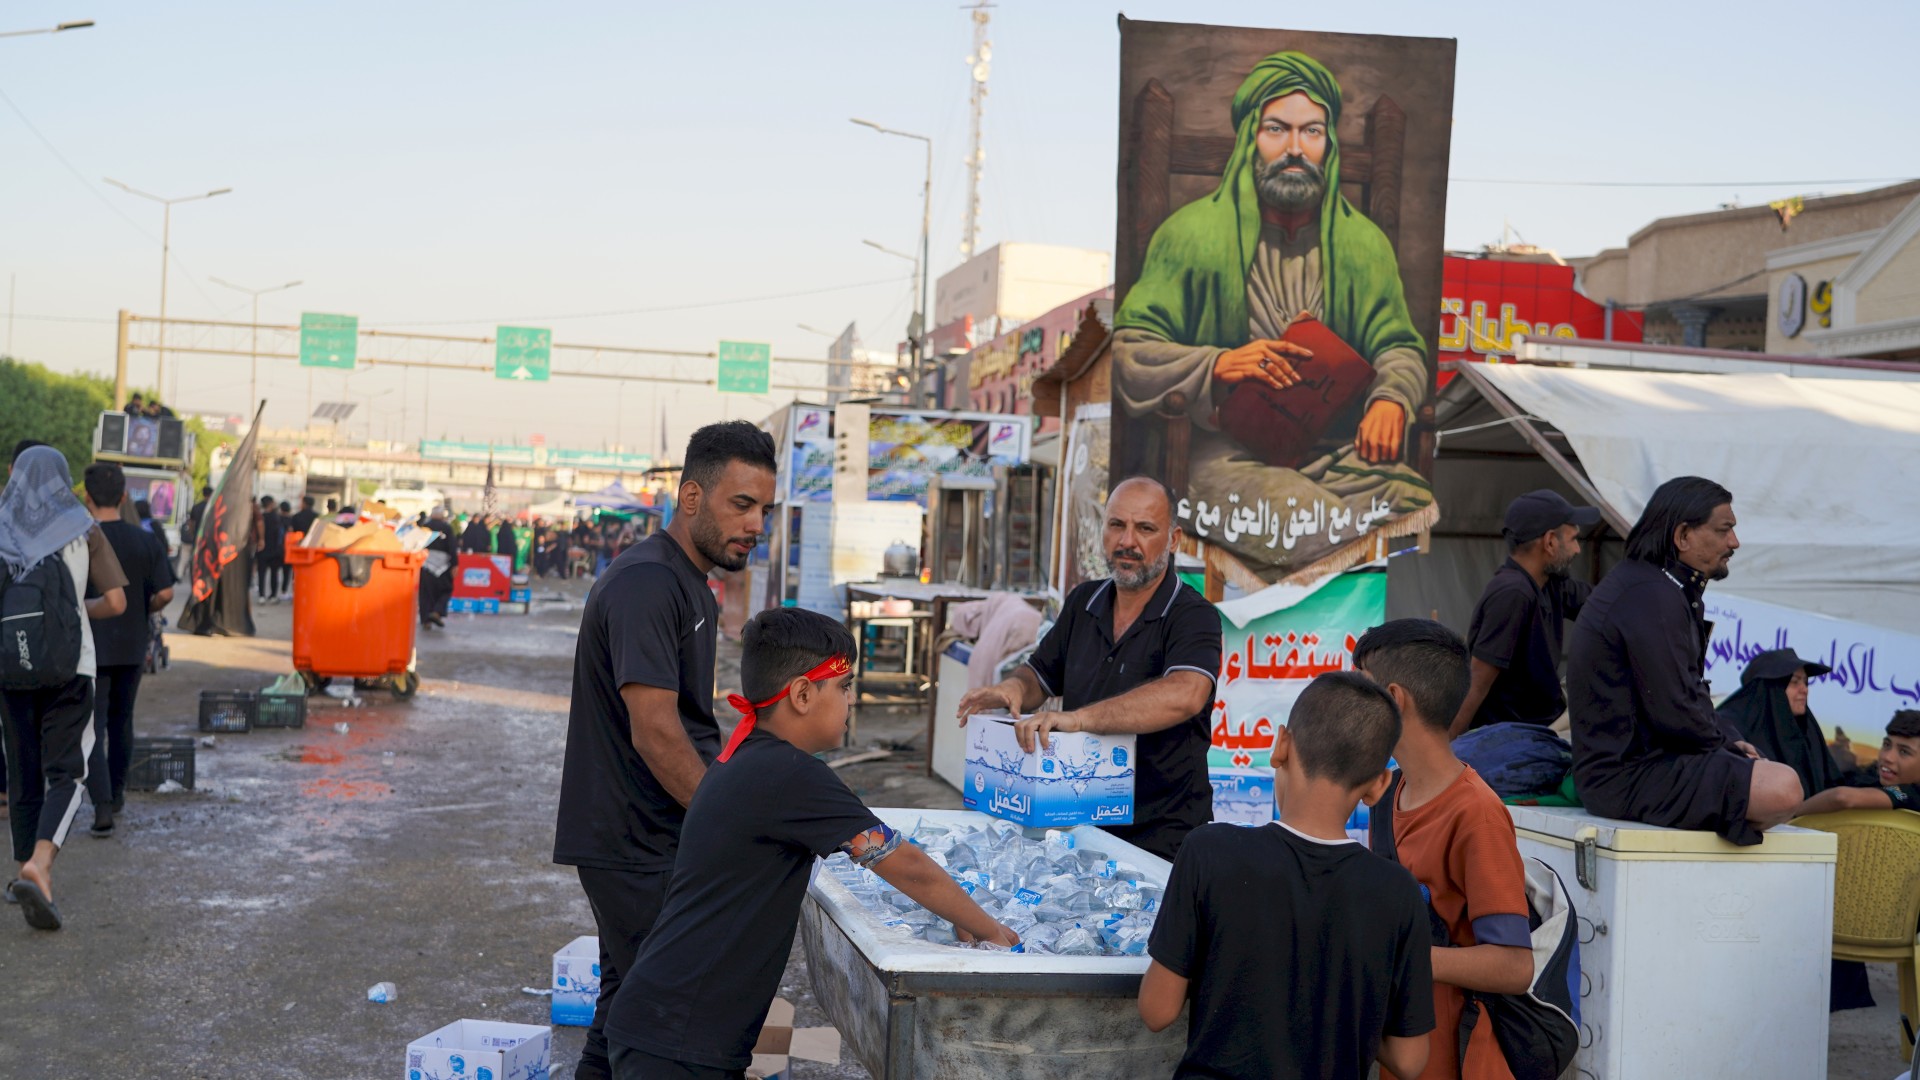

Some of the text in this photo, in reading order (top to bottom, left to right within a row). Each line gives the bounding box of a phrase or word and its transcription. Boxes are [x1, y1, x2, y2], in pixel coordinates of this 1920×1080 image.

[1195, 499, 1221, 536] مع
[1223, 493, 1280, 549] والحق
[1282, 496, 1325, 550] الحق
[1328, 503, 1351, 544] مع
[1355, 495, 1391, 536] علي
[989, 786, 1031, 816] الكفيل
[1090, 804, 1129, 821] الكفيل
